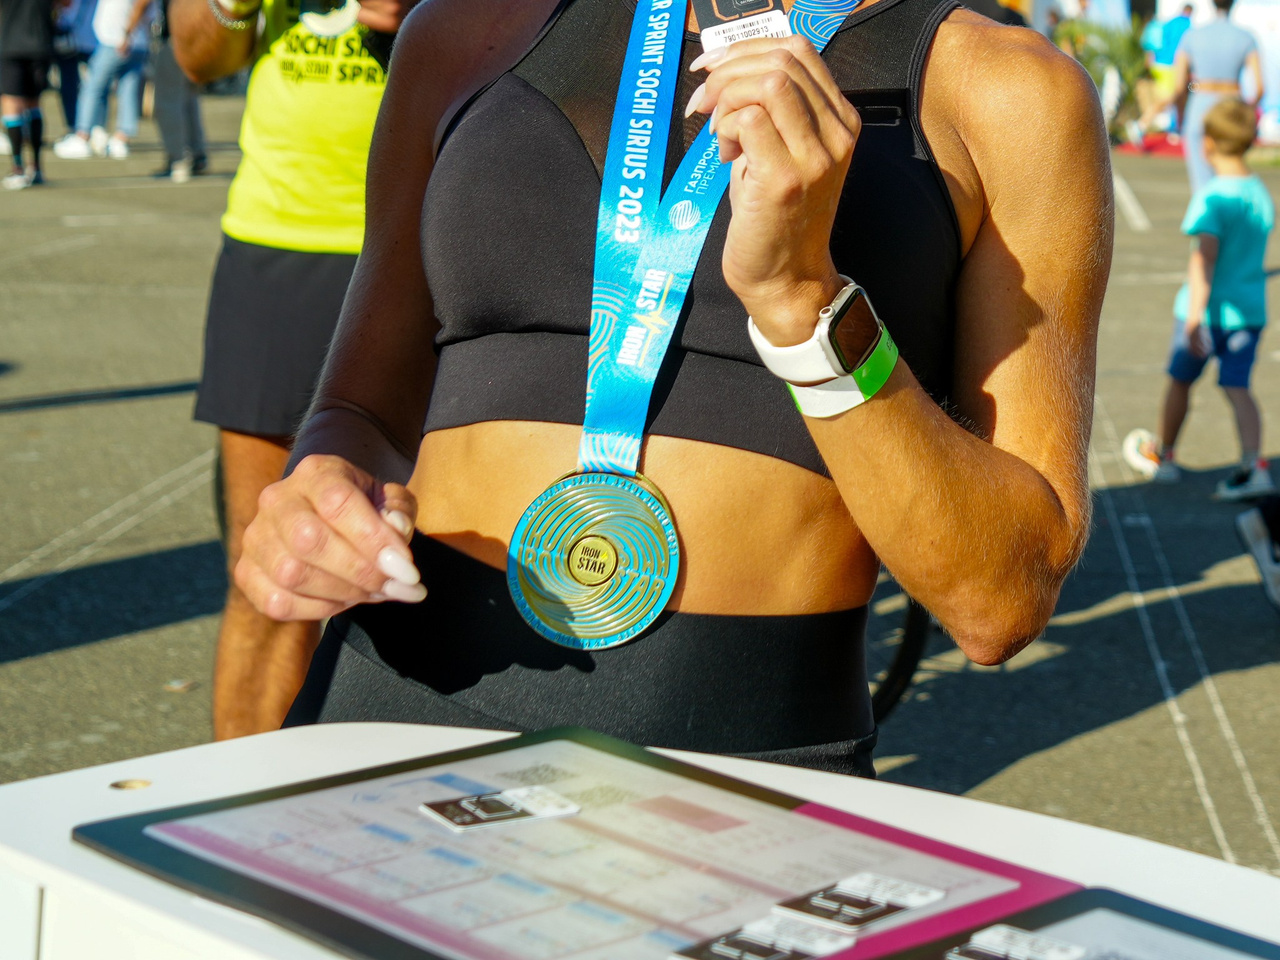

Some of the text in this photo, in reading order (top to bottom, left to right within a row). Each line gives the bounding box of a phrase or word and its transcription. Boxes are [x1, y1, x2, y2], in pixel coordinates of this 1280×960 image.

[641, 12, 670, 64] SPRINT
[632, 67, 661, 116] SOCHI
[622, 118, 653, 180] SIRIUS
[684, 137, 719, 193] ГАЗПРОМ
[695, 154, 720, 195] ПРЕМ
[614, 185, 644, 243] 2023
[616, 268, 667, 366] IRON STAR
[577, 556, 606, 575] STAR
[581, 546, 600, 559] IRON
